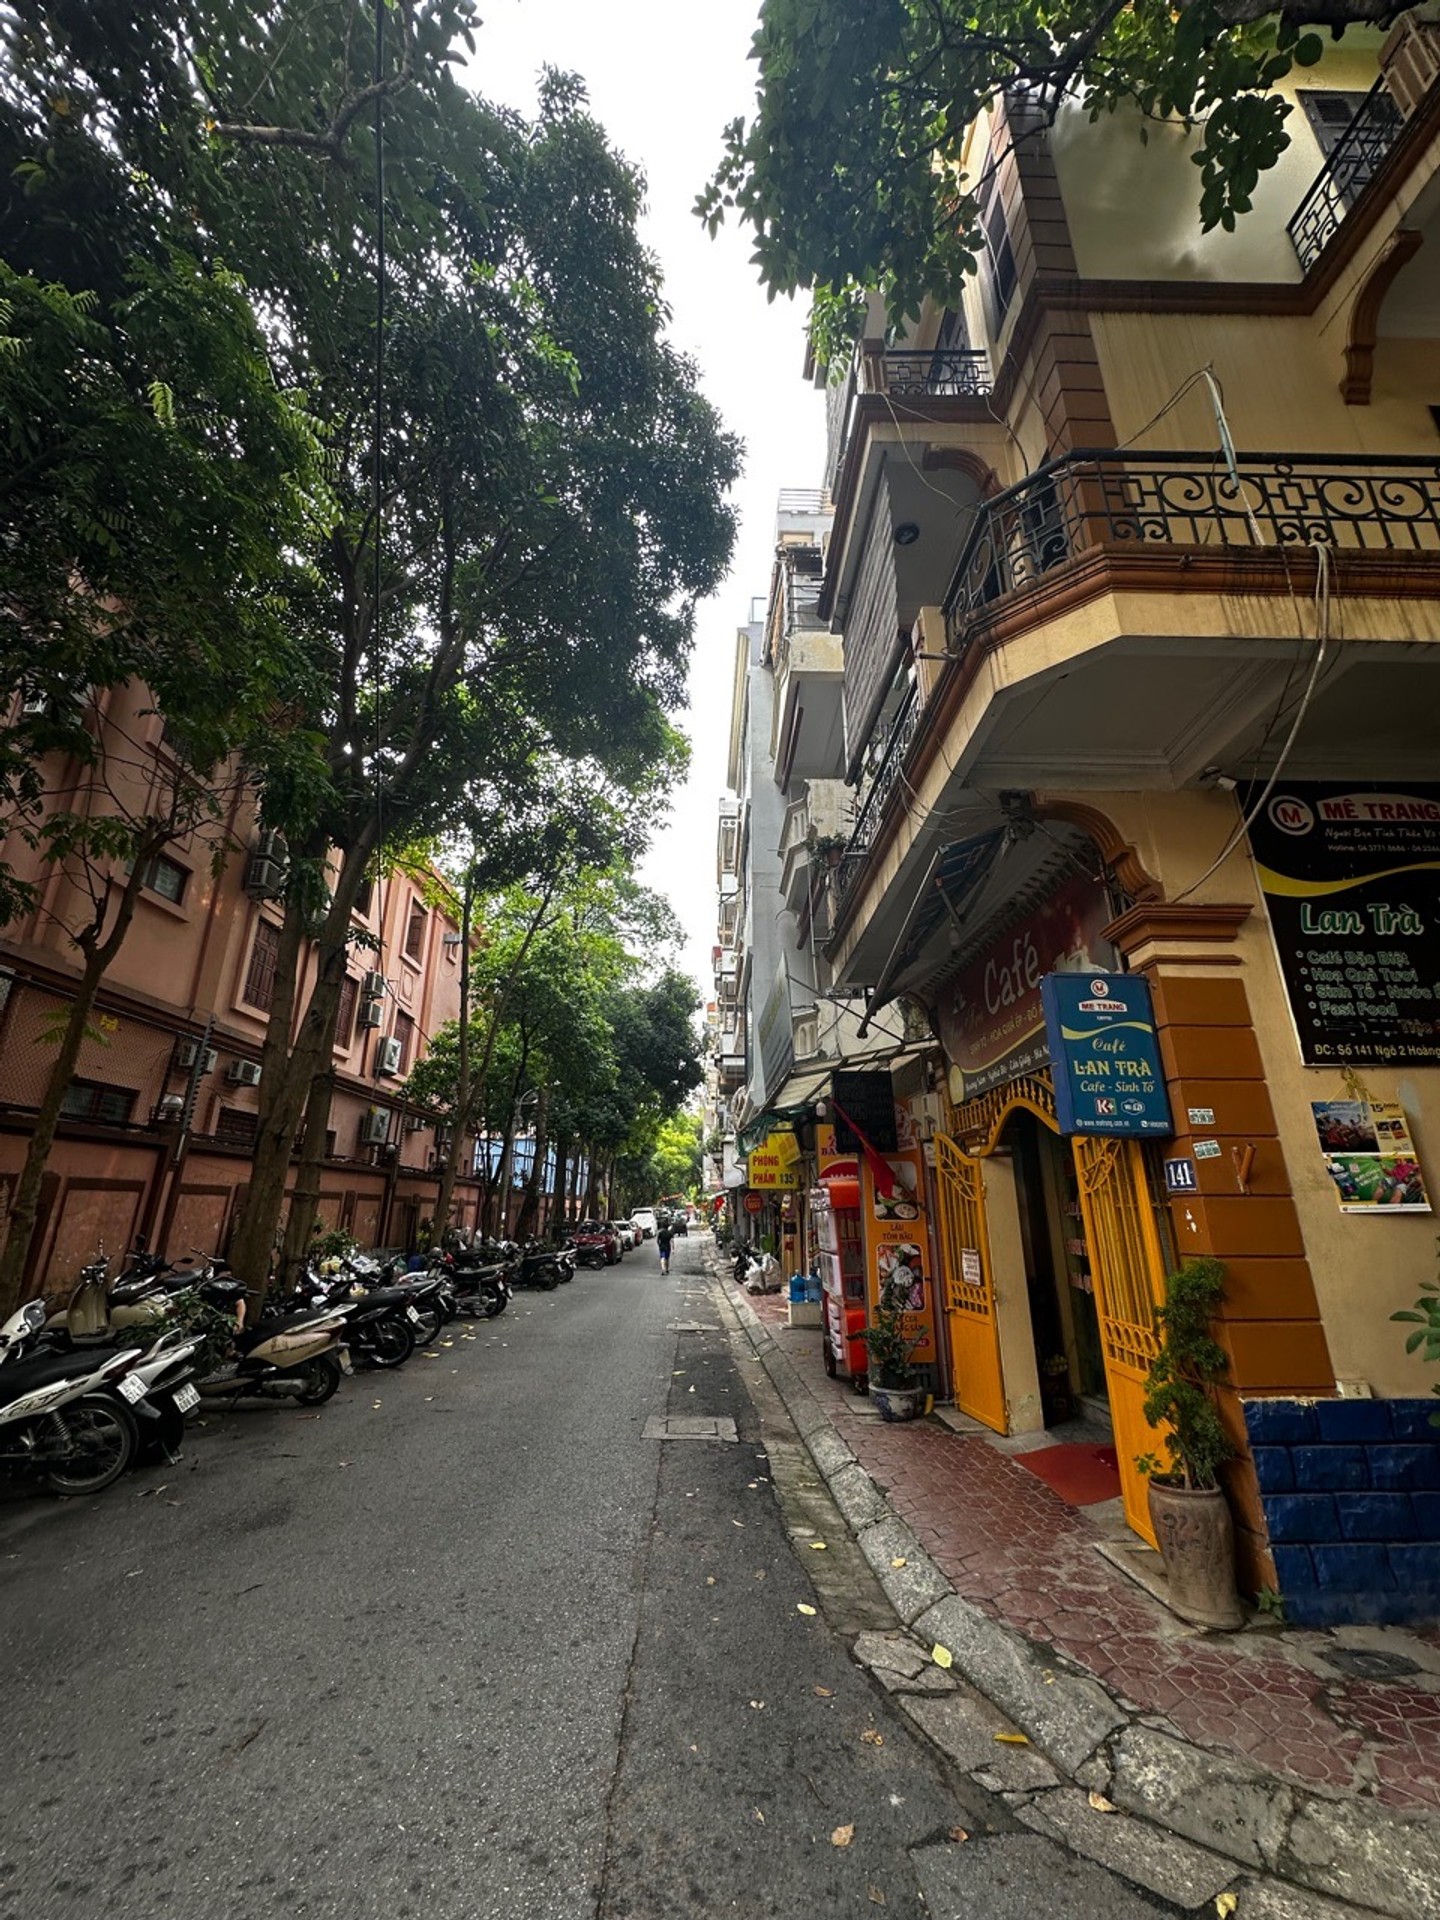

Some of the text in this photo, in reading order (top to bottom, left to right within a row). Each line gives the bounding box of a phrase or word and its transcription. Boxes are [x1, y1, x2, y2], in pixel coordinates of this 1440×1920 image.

[1322, 798, 1440, 820] MÊ TRANG
[1301, 902, 1424, 935] Lan Trà
[984, 931, 1040, 1014] Café
[1315, 983, 1353, 998] Sinh
[1319, 1000, 1399, 1016] Fast Food
[1092, 1037, 1127, 1055] Café
[1355, 1044, 1373, 1056] 141
[1399, 1045, 1406, 1056] 2
[1073, 1057, 1153, 1077] LAN TRÀ
[1115, 1080, 1140, 1092] Sinh
[1142, 1080, 1156, 1093] Tố
[1168, 1162, 1192, 1186] 141
